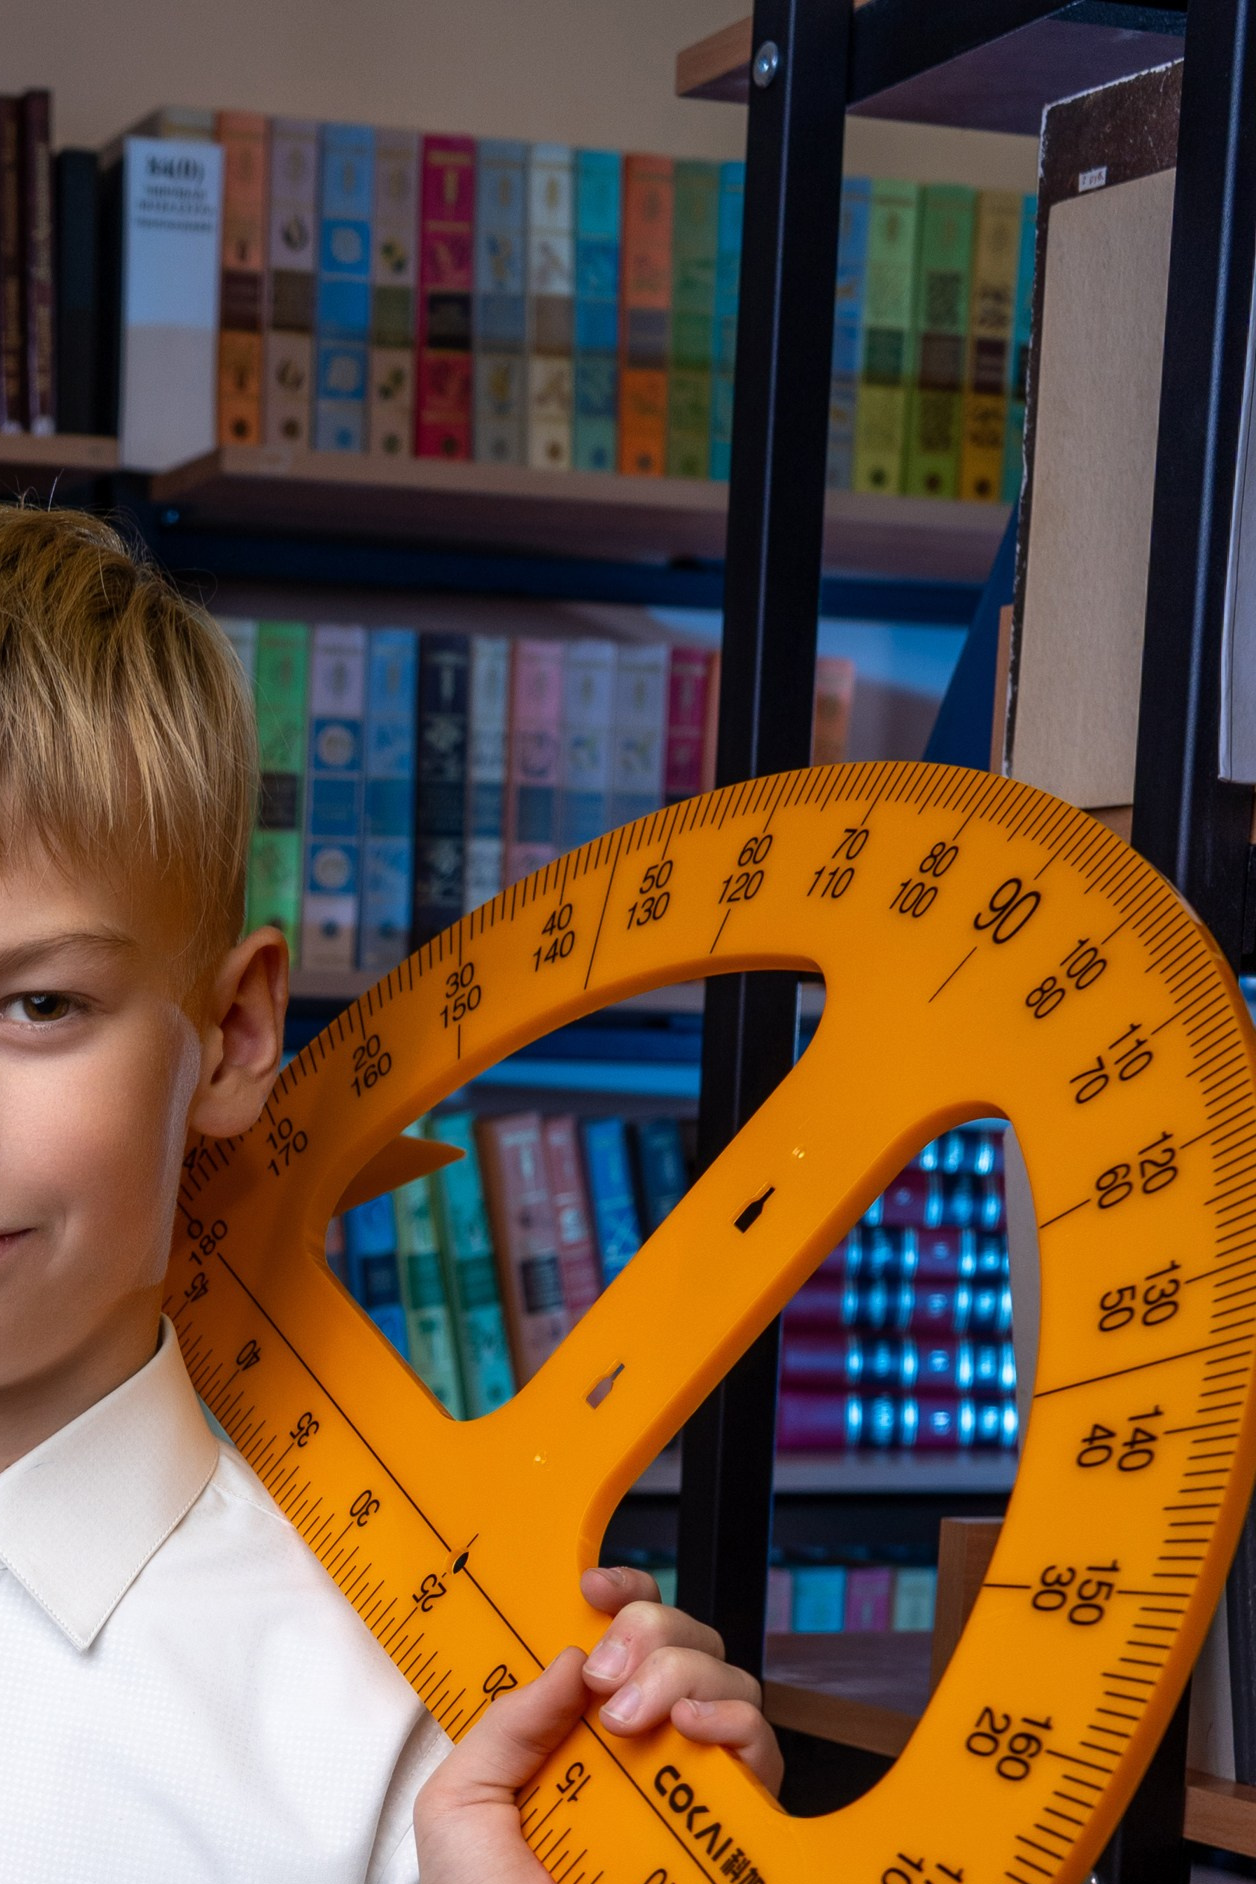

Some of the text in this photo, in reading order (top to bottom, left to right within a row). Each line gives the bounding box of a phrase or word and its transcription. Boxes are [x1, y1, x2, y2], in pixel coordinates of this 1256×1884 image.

[737, 833, 774, 868] 60
[831, 827, 870, 861] 70
[918, 841, 960, 879] 80
[638, 859, 674, 895] 50
[718, 869, 765, 905] 120
[806, 865, 856, 900] 110
[888, 878, 939, 919] 100
[541, 902, 574, 937] 40
[626, 891, 671, 930] 130
[972, 877, 1042, 945] 90
[532, 929, 576, 972] 140
[1059, 937, 1108, 991] 100
[445, 961, 475, 999] 30
[1024, 975, 1067, 1020] 80
[439, 984, 482, 1029] 150
[352, 1034, 381, 1073] 20
[1108, 1023, 1154, 1082] 110
[350, 1051, 393, 1098] 160
[1069, 1055, 1111, 1105] 70
[266, 1117, 294, 1150] 10
[266, 1130, 309, 1177] 170
[1137, 1131, 1179, 1195] 120
[1095, 1163, 1134, 1210] 60
[187, 1218, 205, 1240] 0
[188, 1218, 229, 1266] 180
[183, 1271, 209, 1303] 45
[1097, 1284, 1137, 1333] 50
[1141, 1260, 1181, 1327] 130
[235, 1338, 262, 1372] 40
[288, 1411, 320, 1449] 35
[1075, 1423, 1117, 1469] 40
[1116, 1405, 1164, 1473] 140
[349, 1489, 381, 1528] 30
[411, 1572, 448, 1613] 25
[1031, 1565, 1077, 1613] 30
[1067, 1560, 1121, 1627] 150
[482, 1663, 519, 1703] 20
[965, 1706, 1012, 1758] 20
[995, 1717, 1053, 1782] 160
[555, 1761, 592, 1803] 15
[653, 1764, 734, 1863] COKAI
